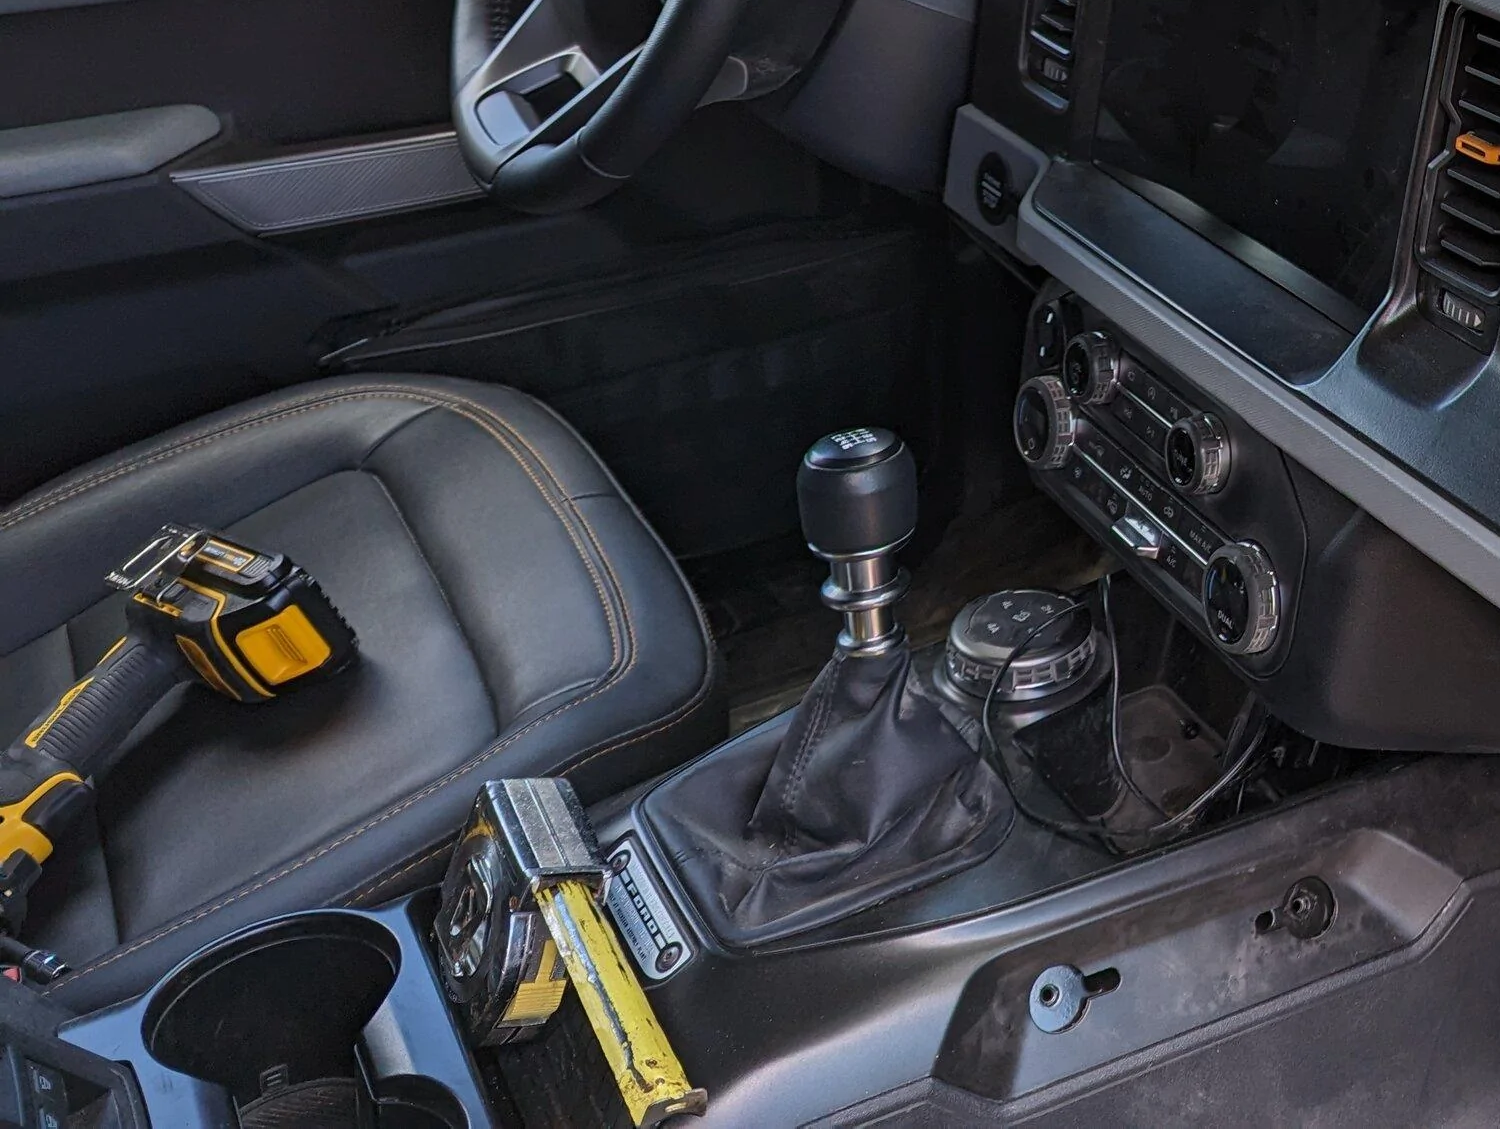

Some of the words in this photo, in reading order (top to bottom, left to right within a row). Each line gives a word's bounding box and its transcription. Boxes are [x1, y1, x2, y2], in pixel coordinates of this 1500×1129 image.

[1138, 485, 1153, 502] AUTO
[1217, 609, 1234, 630] DUAL
[626, 882, 659, 934] FORD
